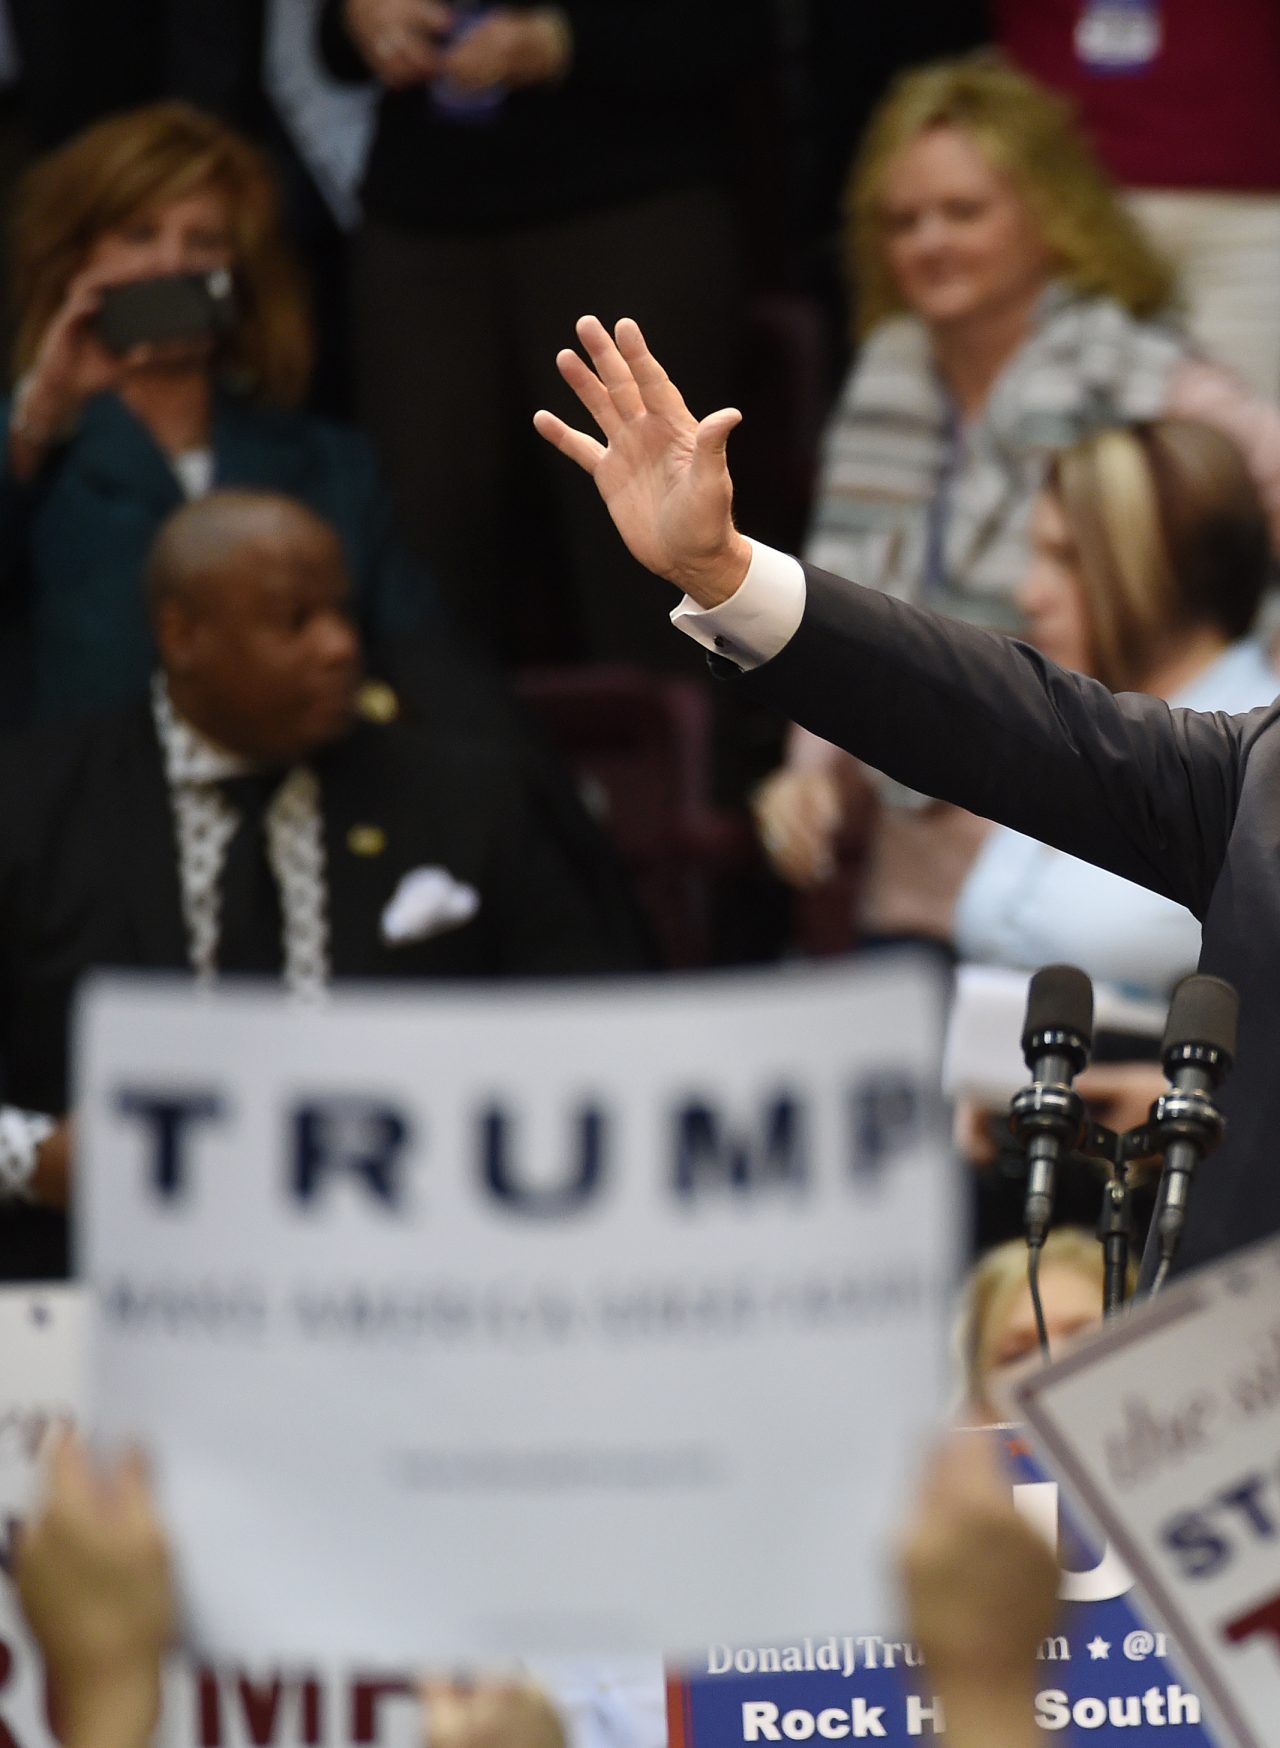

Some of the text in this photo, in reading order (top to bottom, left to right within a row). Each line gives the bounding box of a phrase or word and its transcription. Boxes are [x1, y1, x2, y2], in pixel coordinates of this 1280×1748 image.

[112, 1072, 922, 1226] TRUMP
[742, 1697, 888, 1742] Rock
[1034, 1684, 1201, 1730] South
